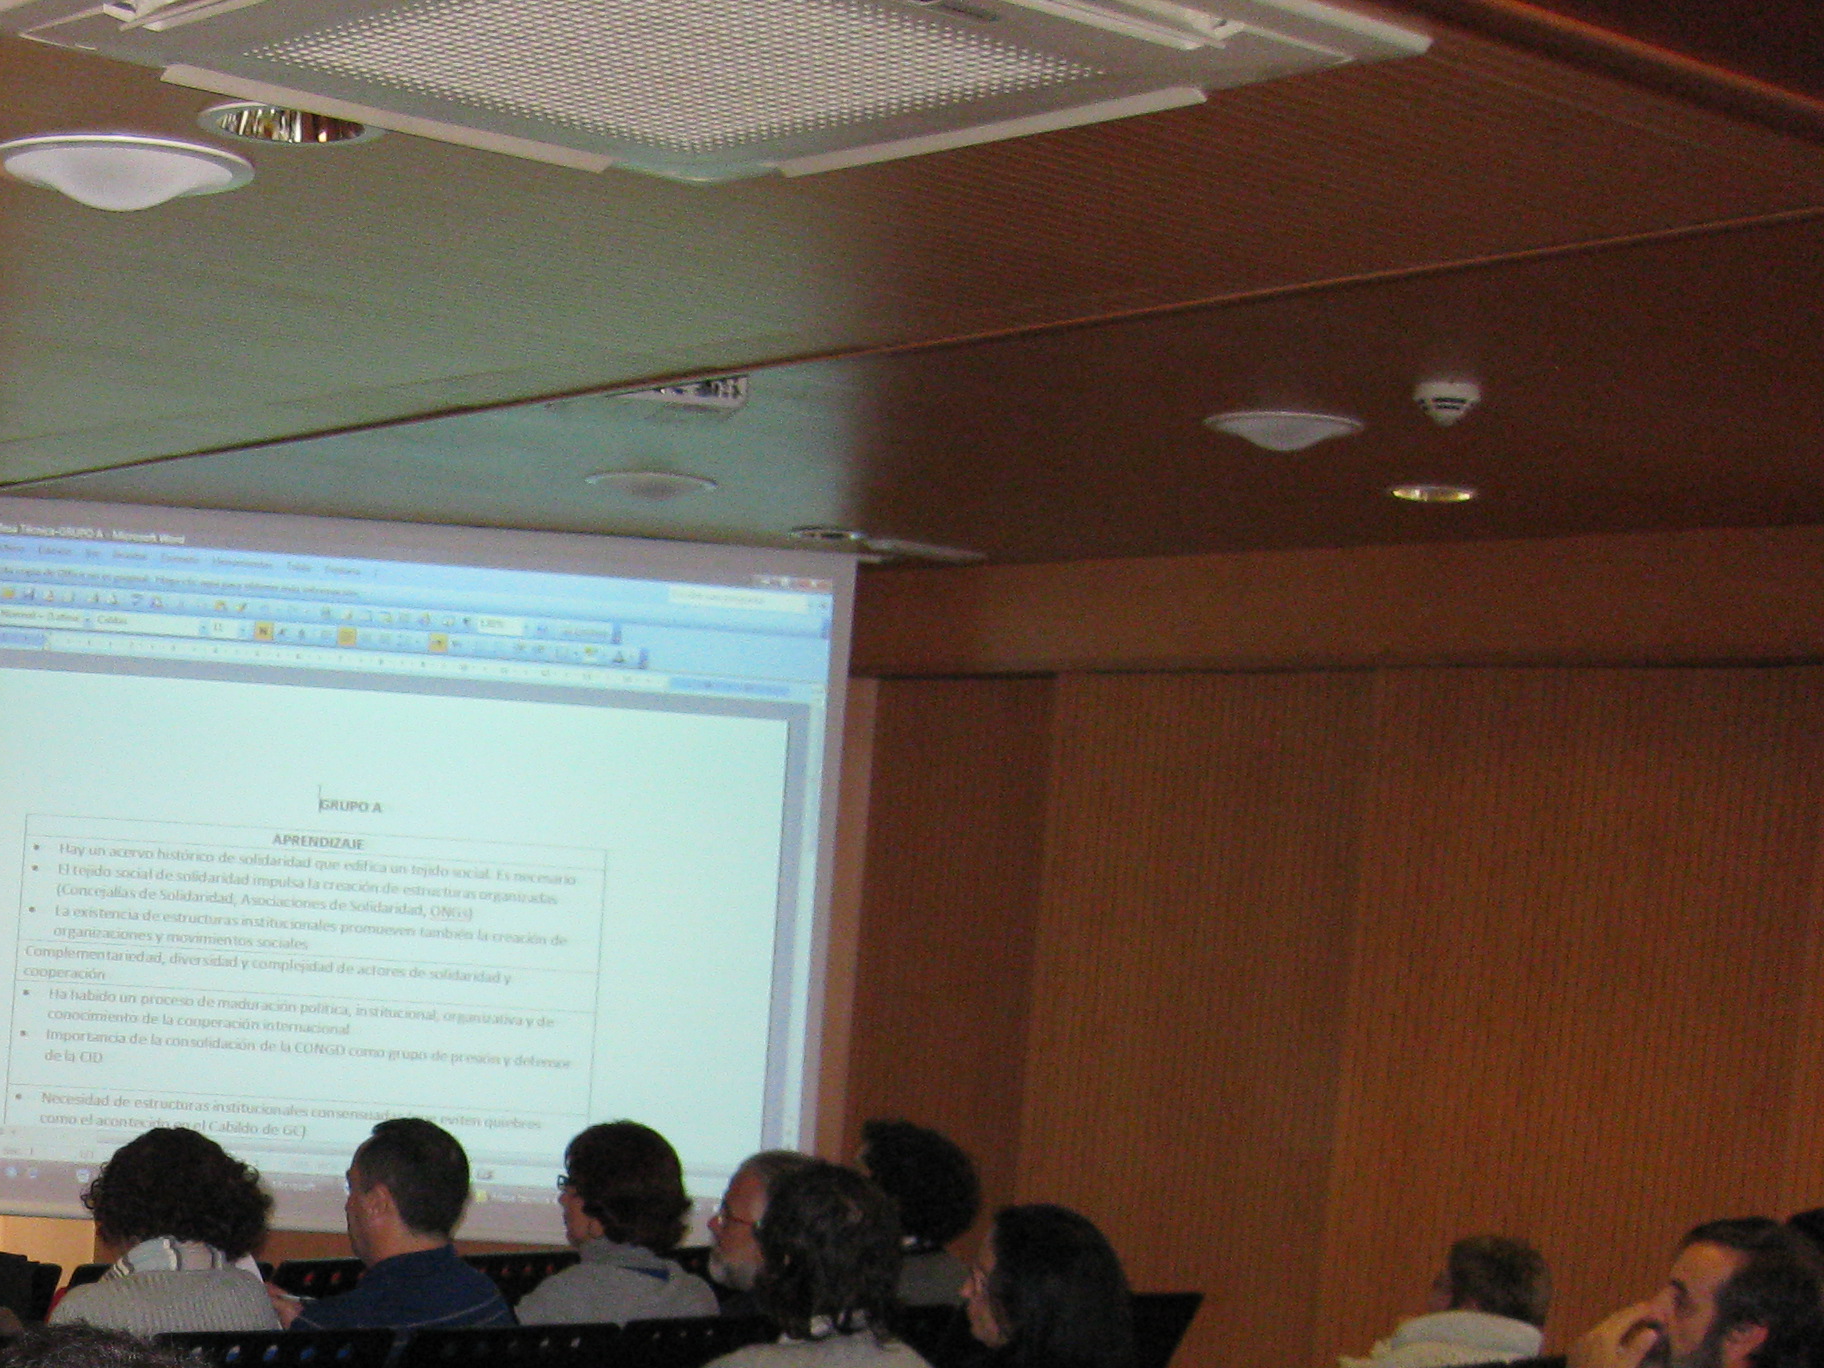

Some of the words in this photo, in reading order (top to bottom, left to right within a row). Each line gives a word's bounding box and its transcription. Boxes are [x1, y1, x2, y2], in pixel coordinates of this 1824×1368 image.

[321, 799, 369, 813] GRUPO
[371, 802, 383, 813] A
[89, 846, 106, 857] un
[218, 852, 234, 863] de
[115, 867, 152, 881] social
[159, 869, 173, 881] de
[177, 871, 249, 886] solidaridad
[382, 882, 399, 894] de
[139, 888, 156, 900] de
[329, 898, 347, 910] de
[56, 905, 68, 917] La
[143, 910, 159, 921] de
[337, 962, 354, 974] de
[409, 966, 426, 978] de
[49, 988, 67, 1000] Ha
[119, 994, 136, 1004] un
[198, 997, 214, 1008] de
[142, 1013, 158, 1025] de
[162, 1014, 173, 1026] la
[130, 1032, 147, 1044] de
[151, 1033, 161, 1046] la
[260, 1039, 276, 1051] de
[45, 1050, 62, 1061] de
[114, 1095, 130, 1107] de
[80, 1114, 93, 1126] el
[263, 1123, 278, 1136] de
